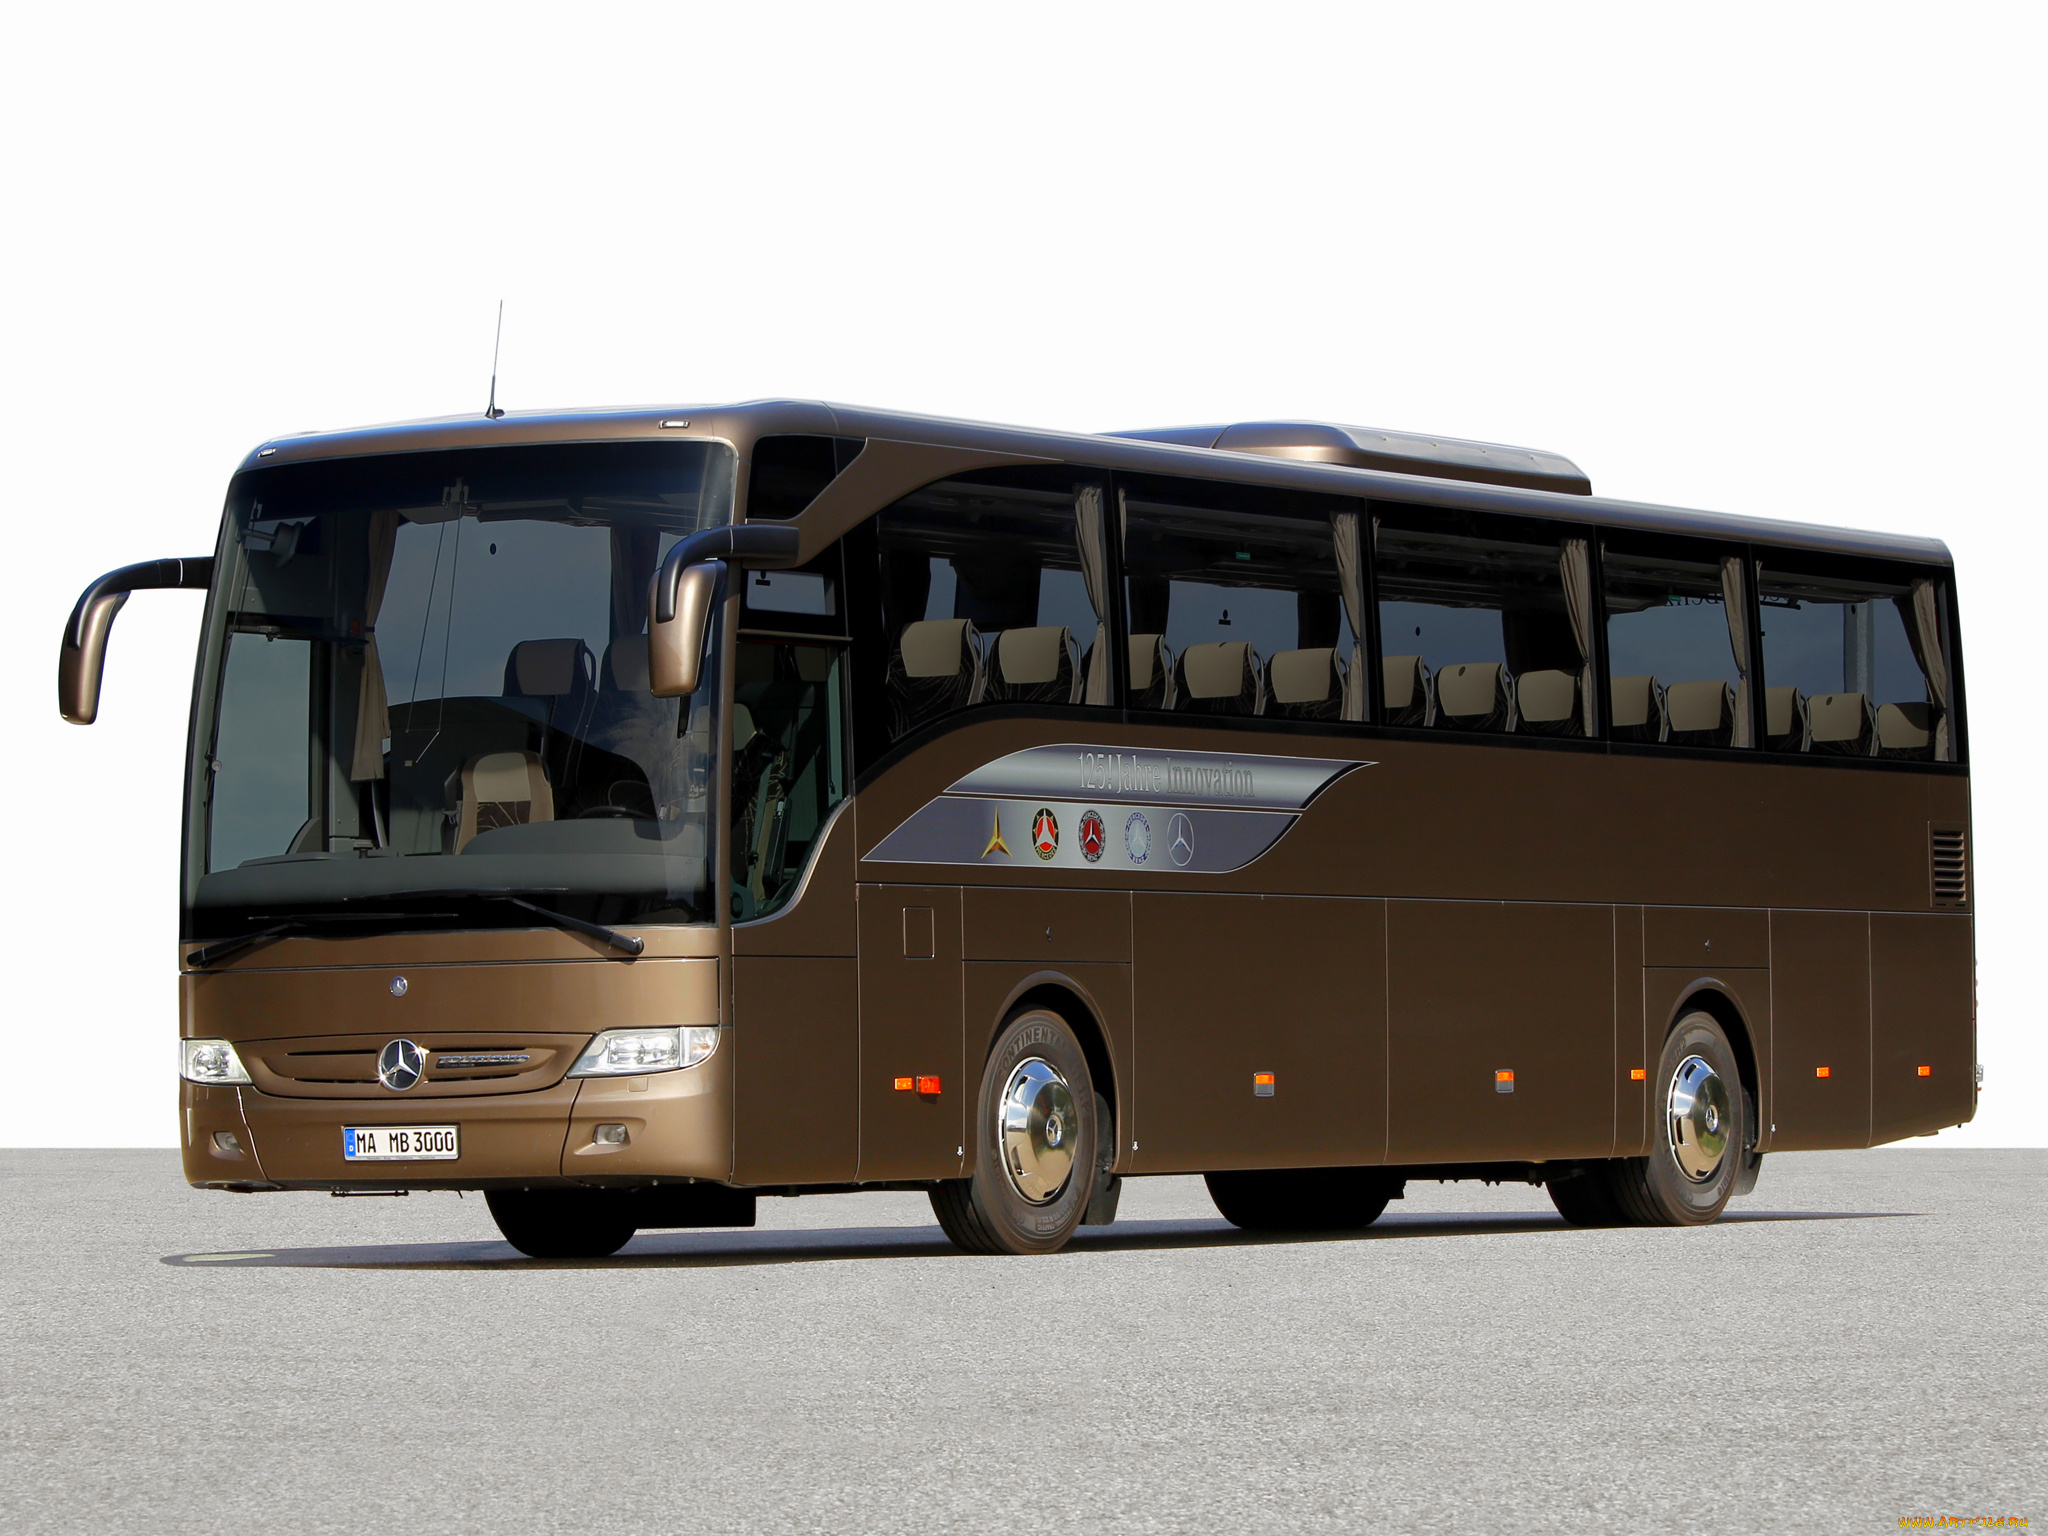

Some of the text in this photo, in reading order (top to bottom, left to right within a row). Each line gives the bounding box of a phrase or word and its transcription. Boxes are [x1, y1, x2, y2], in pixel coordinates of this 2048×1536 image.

[1078, 752, 1255, 798] 125! Jahre Innovation
[437, 1054, 531, 1064] TOURISMO
[356, 1131, 454, 1153] MA MB 3000
